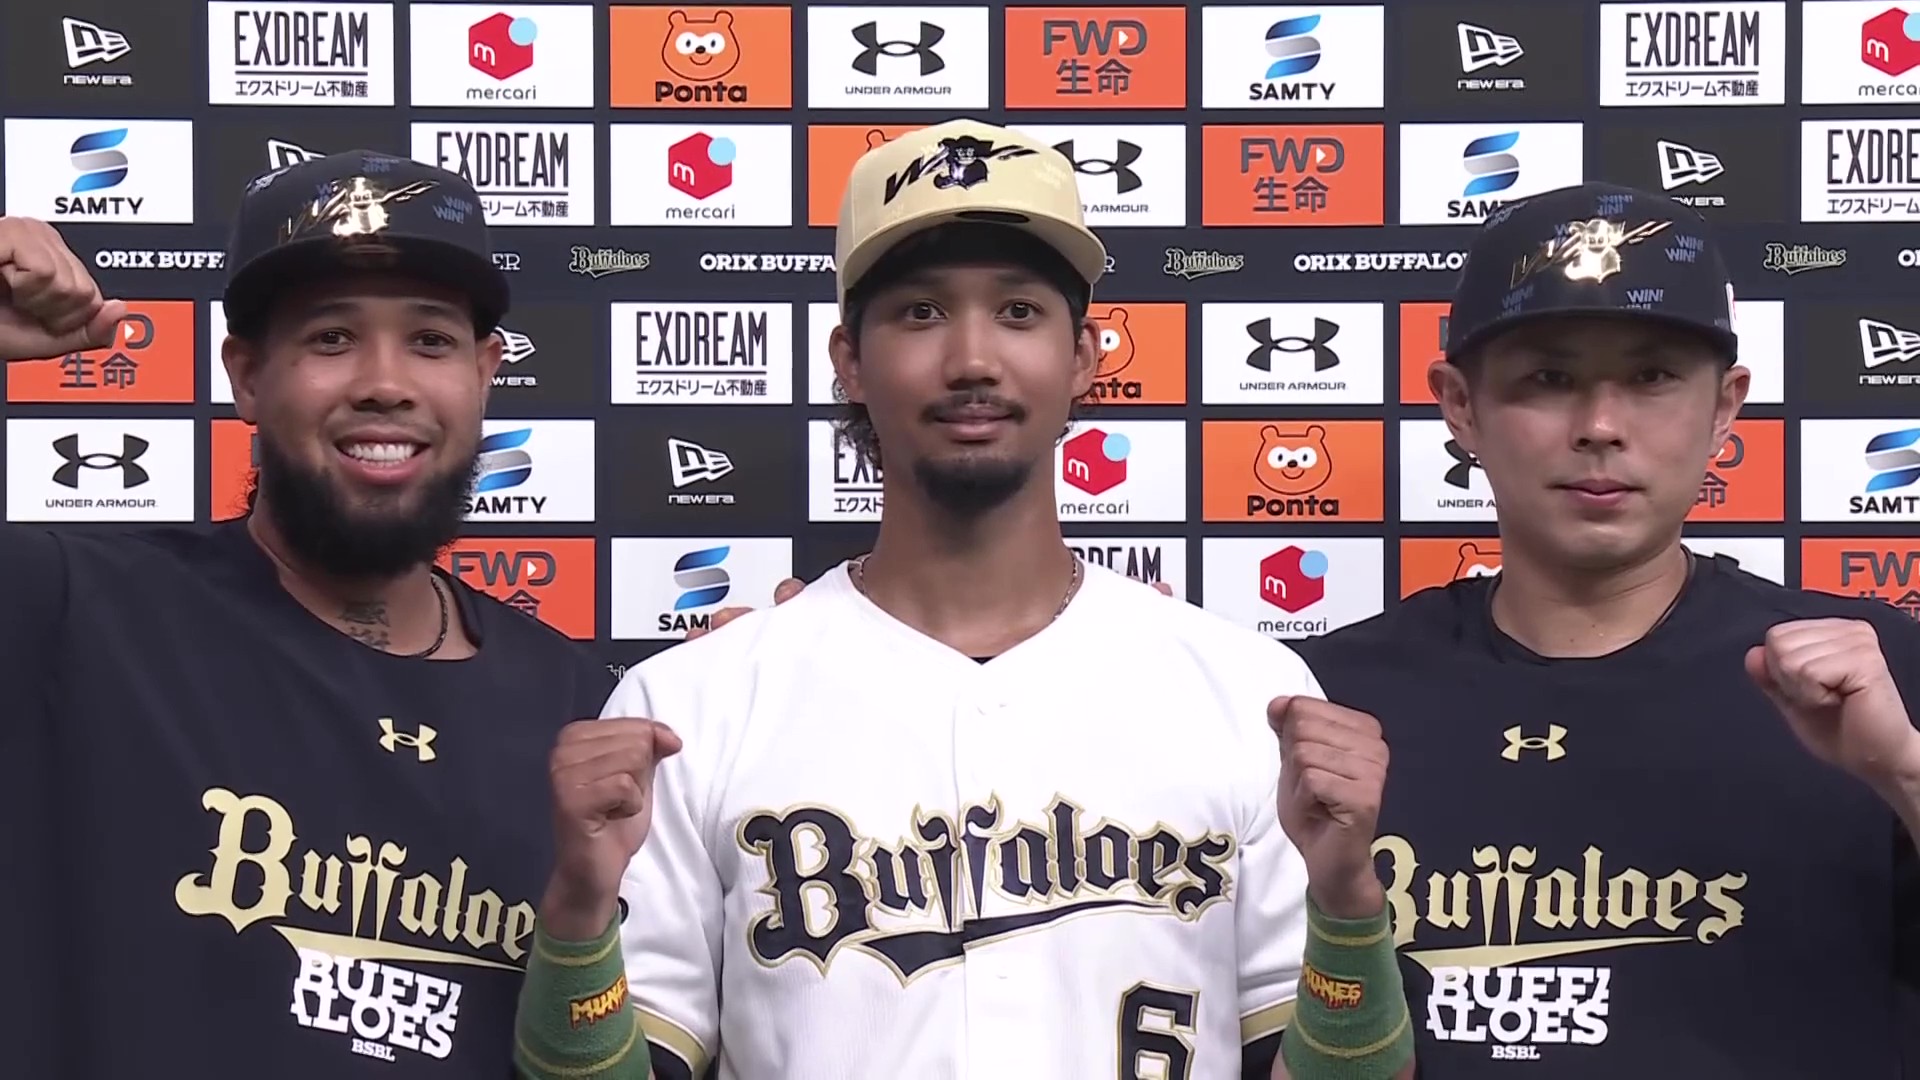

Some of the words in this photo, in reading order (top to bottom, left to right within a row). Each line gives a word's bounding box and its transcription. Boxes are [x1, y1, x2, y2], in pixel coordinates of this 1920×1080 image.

[235, 11, 369, 67] EXDREAM
[1043, 20, 1148, 56] FWD
[1625, 12, 1759, 67] EXDREAM
[1055, 59, 1132, 95] 生命
[235, 81, 369, 98] エクスドリーム不動産
[466, 86, 537, 100] mercari
[656, 81, 748, 103] Ponta
[845, 86, 891, 95] UNDER
[894, 86, 952, 95] ARMOUR
[1249, 84, 1336, 101] SAMTY
[1625, 80, 1759, 98] エクスドリーム不動産
[1858, 84, 1920, 97] merca
[437, 131, 569, 187] EXDREAM
[1241, 137, 1345, 173] FWD
[1828, 129, 1920, 185] EXDRE
[1253, 177, 1330, 213] 生命
[55, 196, 144, 216] SAMTY
[481, 201, 569, 218] リーム不動産
[666, 204, 736, 220] mercari
[1091, 204, 1150, 213] ARMOUR
[1448, 200, 1503, 218] SAM
[1828, 198, 1920, 215] エクスドリーム
[95, 250, 155, 269] ORIX
[569, 246, 650, 278] Buffaloes
[700, 253, 758, 271] ORIX
[760, 254, 837, 272] BUFFA
[1163, 248, 1244, 279] Buffaloes
[1294, 254, 1352, 272] ORIX
[1354, 252, 1467, 271] BUFFALO
[1763, 243, 1847, 275] Buffaloes
[1626, 289, 1664, 303] WIN!
[636, 311, 767, 367] EXDREAM
[636, 379, 767, 397] エクスドリーム不動産
[1090, 377, 1142, 398] nta
[1239, 382, 1286, 391] UNDER
[1288, 382, 1347, 391] ARMOUR
[45, 499, 93, 508] UNDER
[95, 499, 157, 508] ARMOUR
[1060, 500, 1130, 515] mercari
[1247, 495, 1339, 517] Ponta
[1437, 499, 1483, 508] UNDER
[1849, 496, 1920, 514] SAMT
[1840, 552, 1920, 587] FW
[658, 613, 711, 632] SAM
[1257, 617, 1328, 633] mercari
[175, 787, 536, 963] Buffaloe
[736, 790, 1238, 980] Buffaloes
[351, 1037, 397, 1063] BSBL
[1490, 1045, 1541, 1060] BSBL
